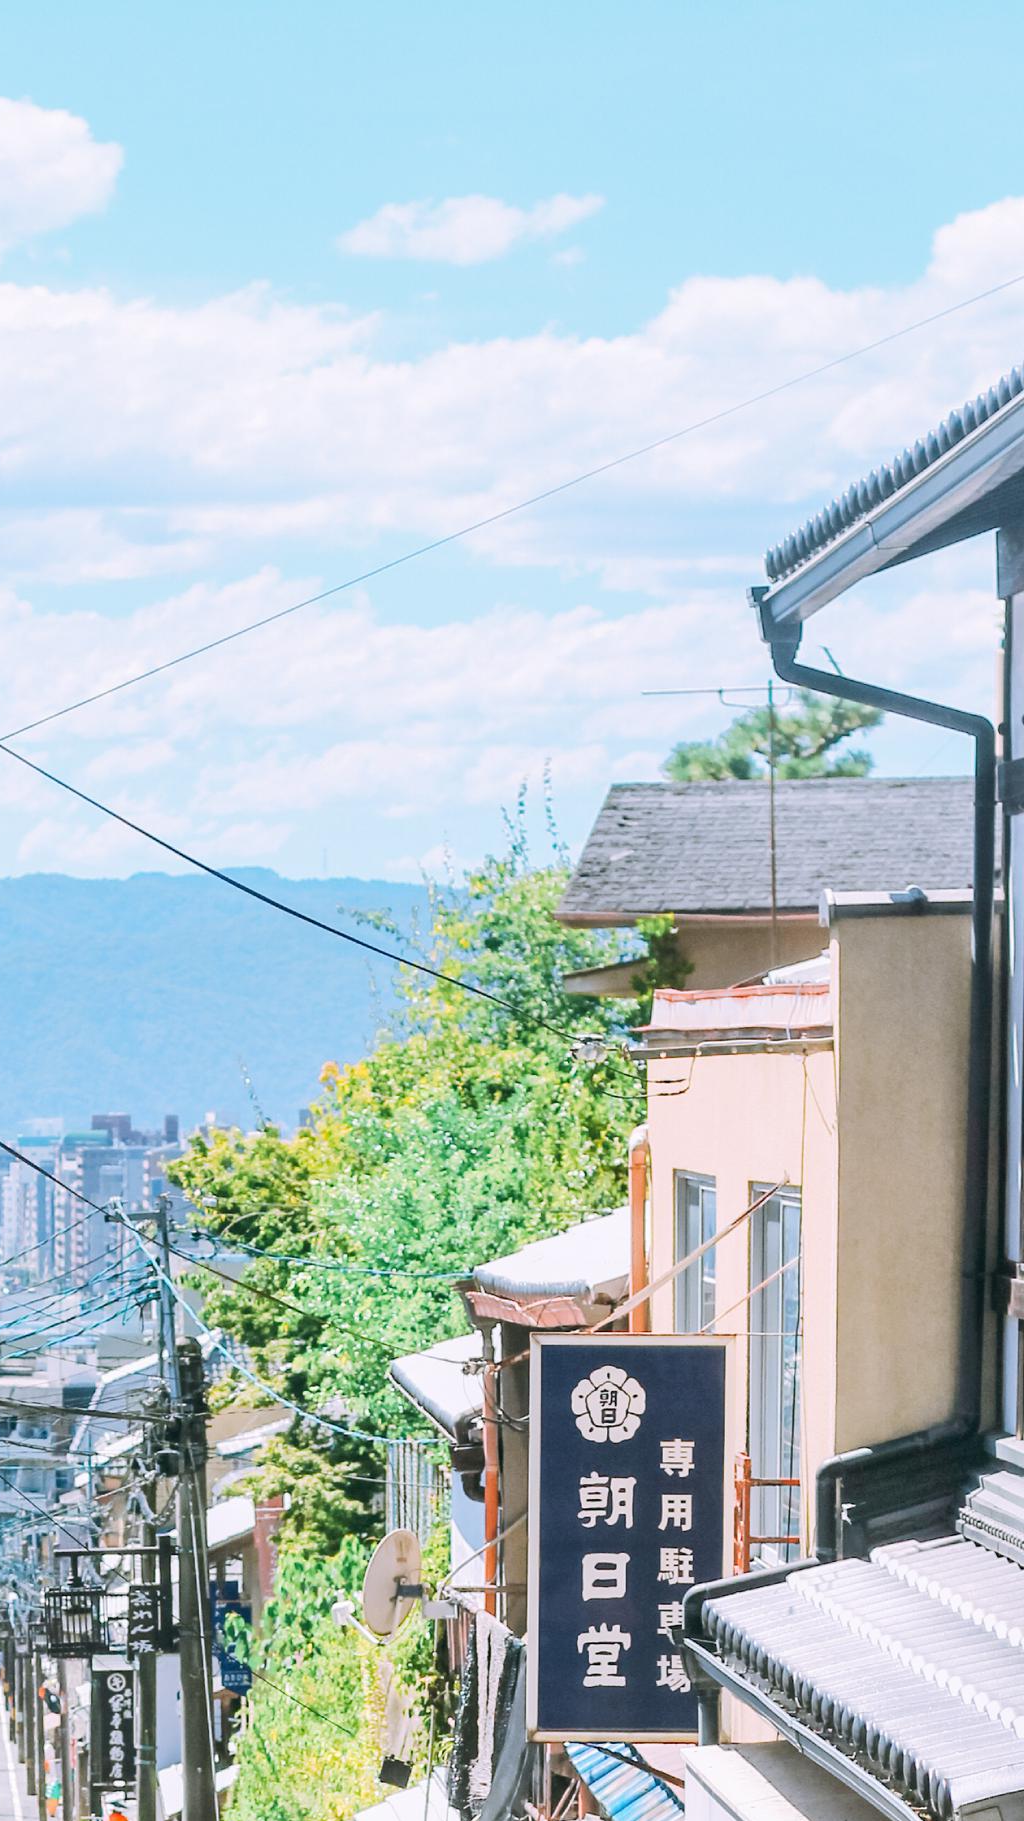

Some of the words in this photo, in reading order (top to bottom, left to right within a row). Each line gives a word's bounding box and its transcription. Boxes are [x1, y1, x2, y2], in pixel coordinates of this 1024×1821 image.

[600, 1388, 618, 1424] 朝日
[129, 1590, 155, 1653] 茶わん坂
[577, 1471, 637, 1688] 朝日堂
[656, 1438, 696, 1693] 専用駐車場
